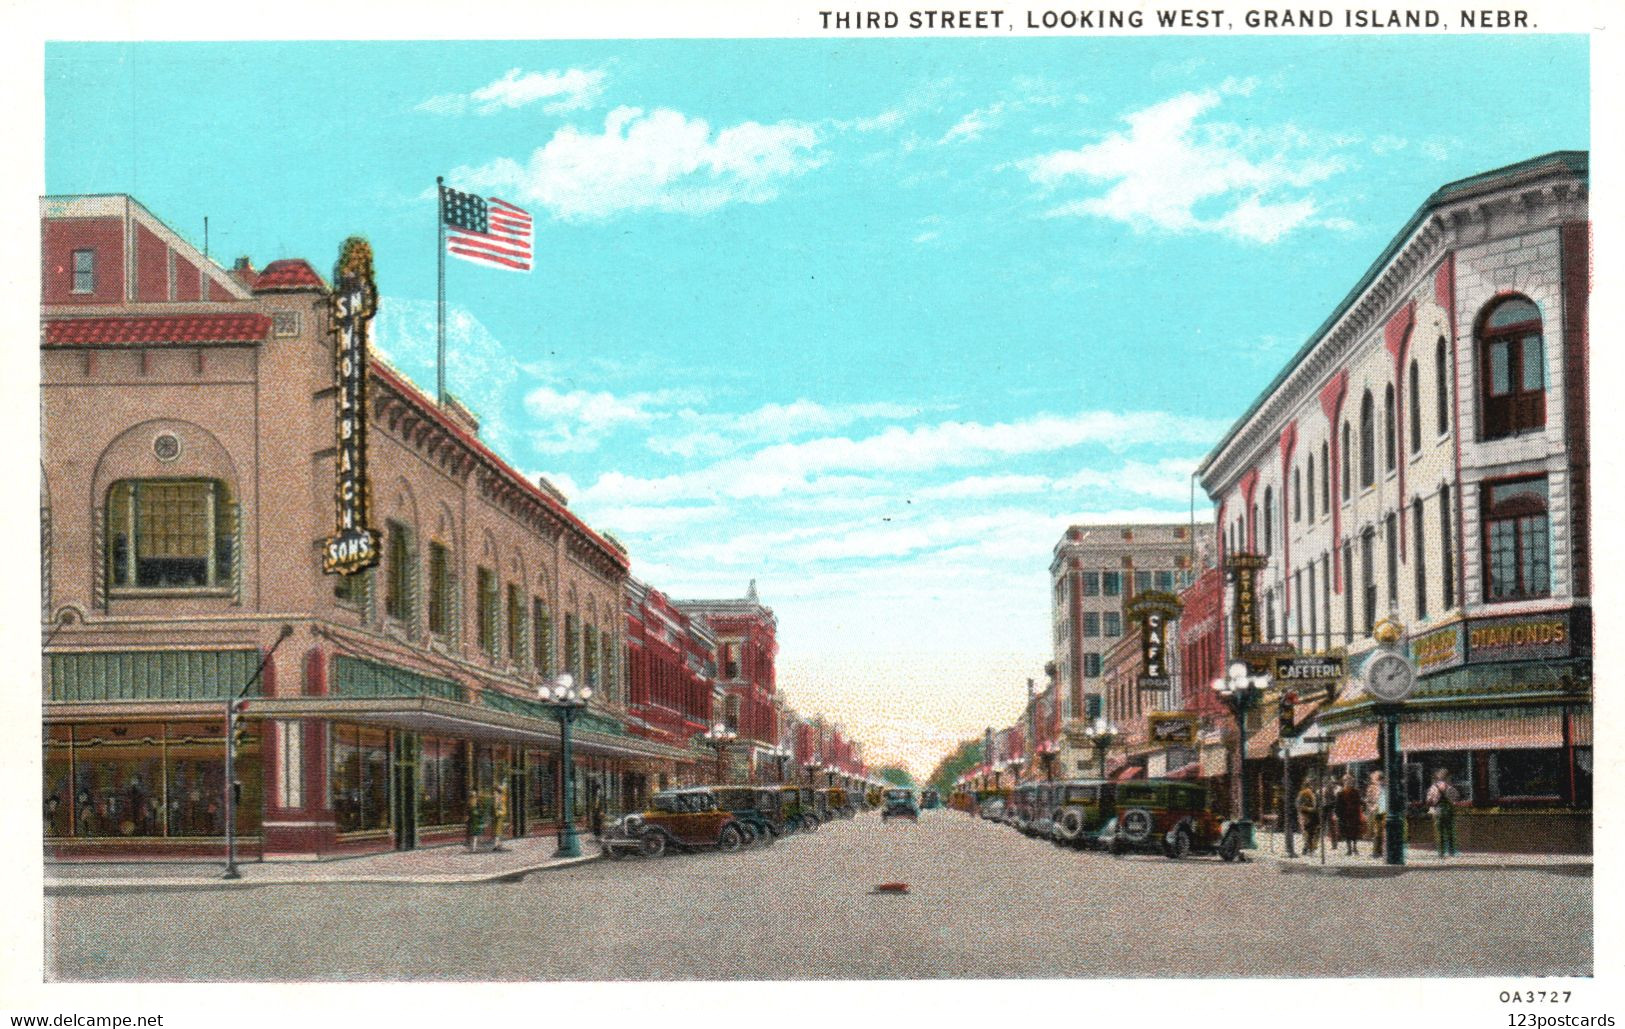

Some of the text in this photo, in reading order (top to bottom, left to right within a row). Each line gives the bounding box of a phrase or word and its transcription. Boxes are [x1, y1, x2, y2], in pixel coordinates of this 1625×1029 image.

[1149, 614, 1161, 677] CAFE
[1471, 623, 1565, 648] DIAMONDS
[1279, 664, 1342, 679] CAFETERIA
